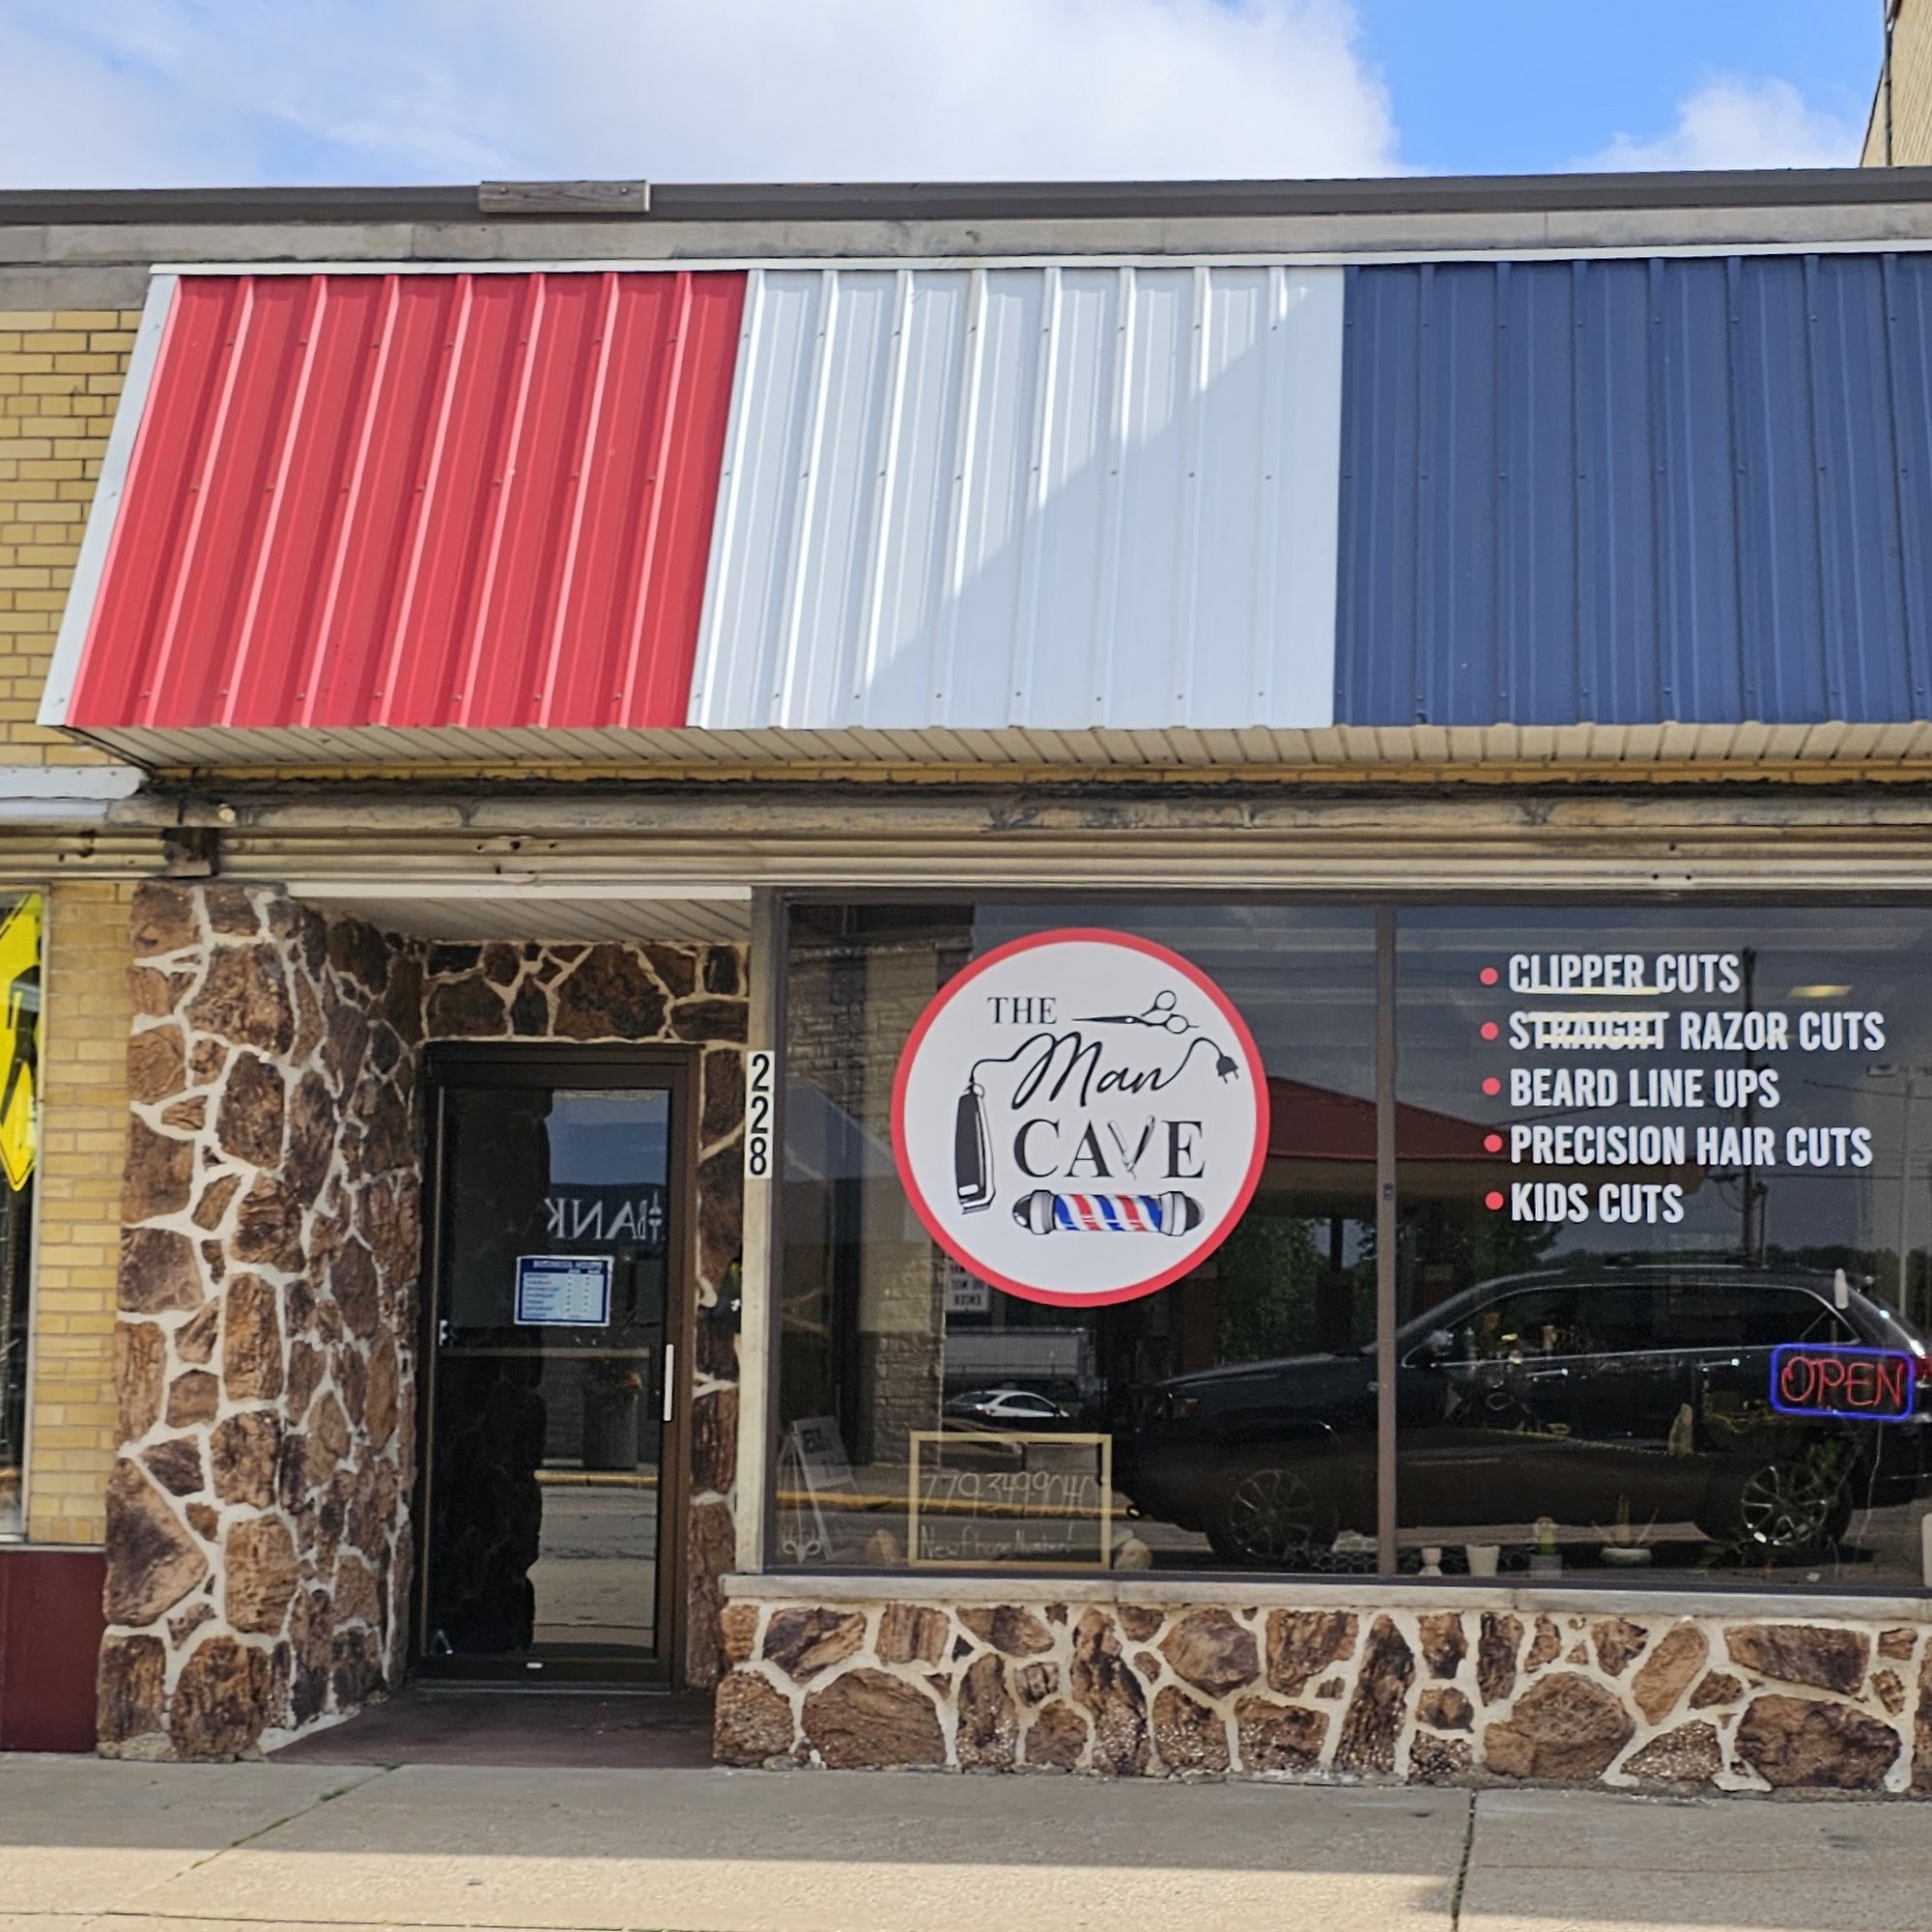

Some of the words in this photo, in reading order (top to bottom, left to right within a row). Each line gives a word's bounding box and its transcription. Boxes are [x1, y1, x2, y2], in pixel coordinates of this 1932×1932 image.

[1509, 953, 1644, 994] CLIPPER
[1656, 954, 1740, 993] CUTS
[987, 997, 1057, 1025] THE
[1509, 1011, 1669, 1050] STRAIGHT
[1680, 1011, 1788, 1051] RAZOR
[1799, 1011, 1886, 1051] CUTS
[1010, 1032, 1163, 1110] Man
[1510, 1068, 1618, 1107] BEARD
[1629, 1069, 1704, 1108] LINE
[1715, 1069, 1780, 1108] UPS
[750, 1053, 771, 1176] 228
[1012, 1116, 1206, 1179] CAVE
[1511, 1125, 1685, 1165] PRECISION
[1696, 1126, 1776, 1166] HAIR
[1786, 1126, 1873, 1167] CUTS
[1511, 1183, 1589, 1223] KIDS
[1599, 1183, 1685, 1223] CUTS
[1781, 1356, 1904, 1407] OPEN
